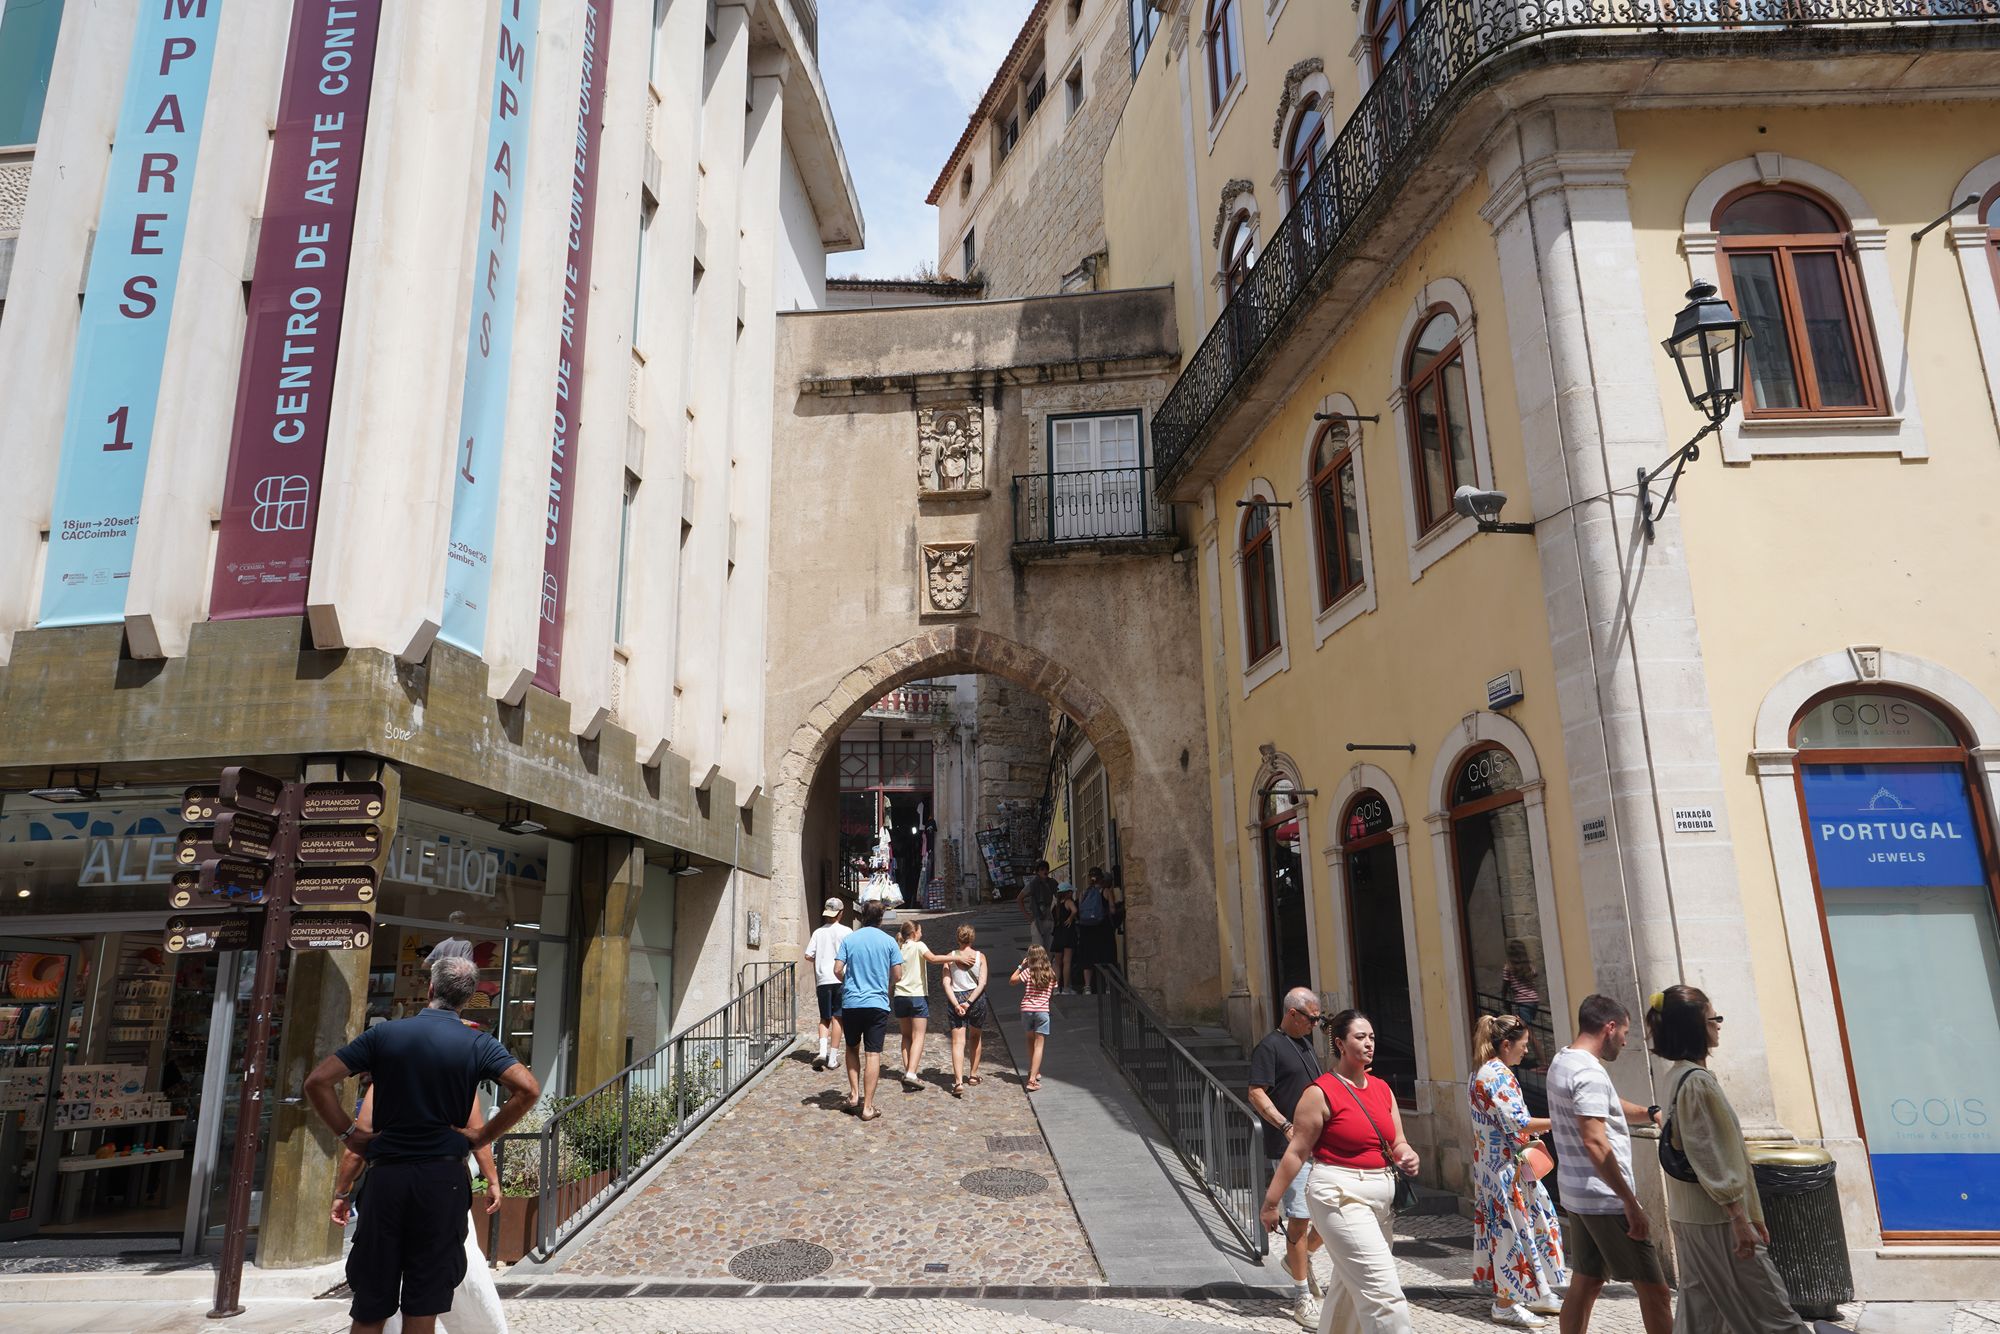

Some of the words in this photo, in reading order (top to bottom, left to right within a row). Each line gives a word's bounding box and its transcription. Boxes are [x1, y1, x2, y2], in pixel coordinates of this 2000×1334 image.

[319, 0, 360, 95] CONT
[304, 112, 345, 205] ARTE
[294, 223, 331, 269] DE
[561, 263, 581, 348] ARTE
[272, 286, 322, 444] CENTRO
[556, 358, 571, 401] DE
[545, 410, 568, 546] CENTRO
[61, 529, 127, 540] CACCoimbra
[448, 551, 475, 567] oimbra
[305, 799, 320, 807] SÃO
[1676, 810, 1712, 819] AFIXAÇÃO
[1678, 821, 1714, 829] PROIBIDA
[1821, 822, 1962, 841] PORTUGAL
[1868, 852, 1926, 863] JEWELS
[291, 927, 354, 935] CONTEMPORÂNEA
